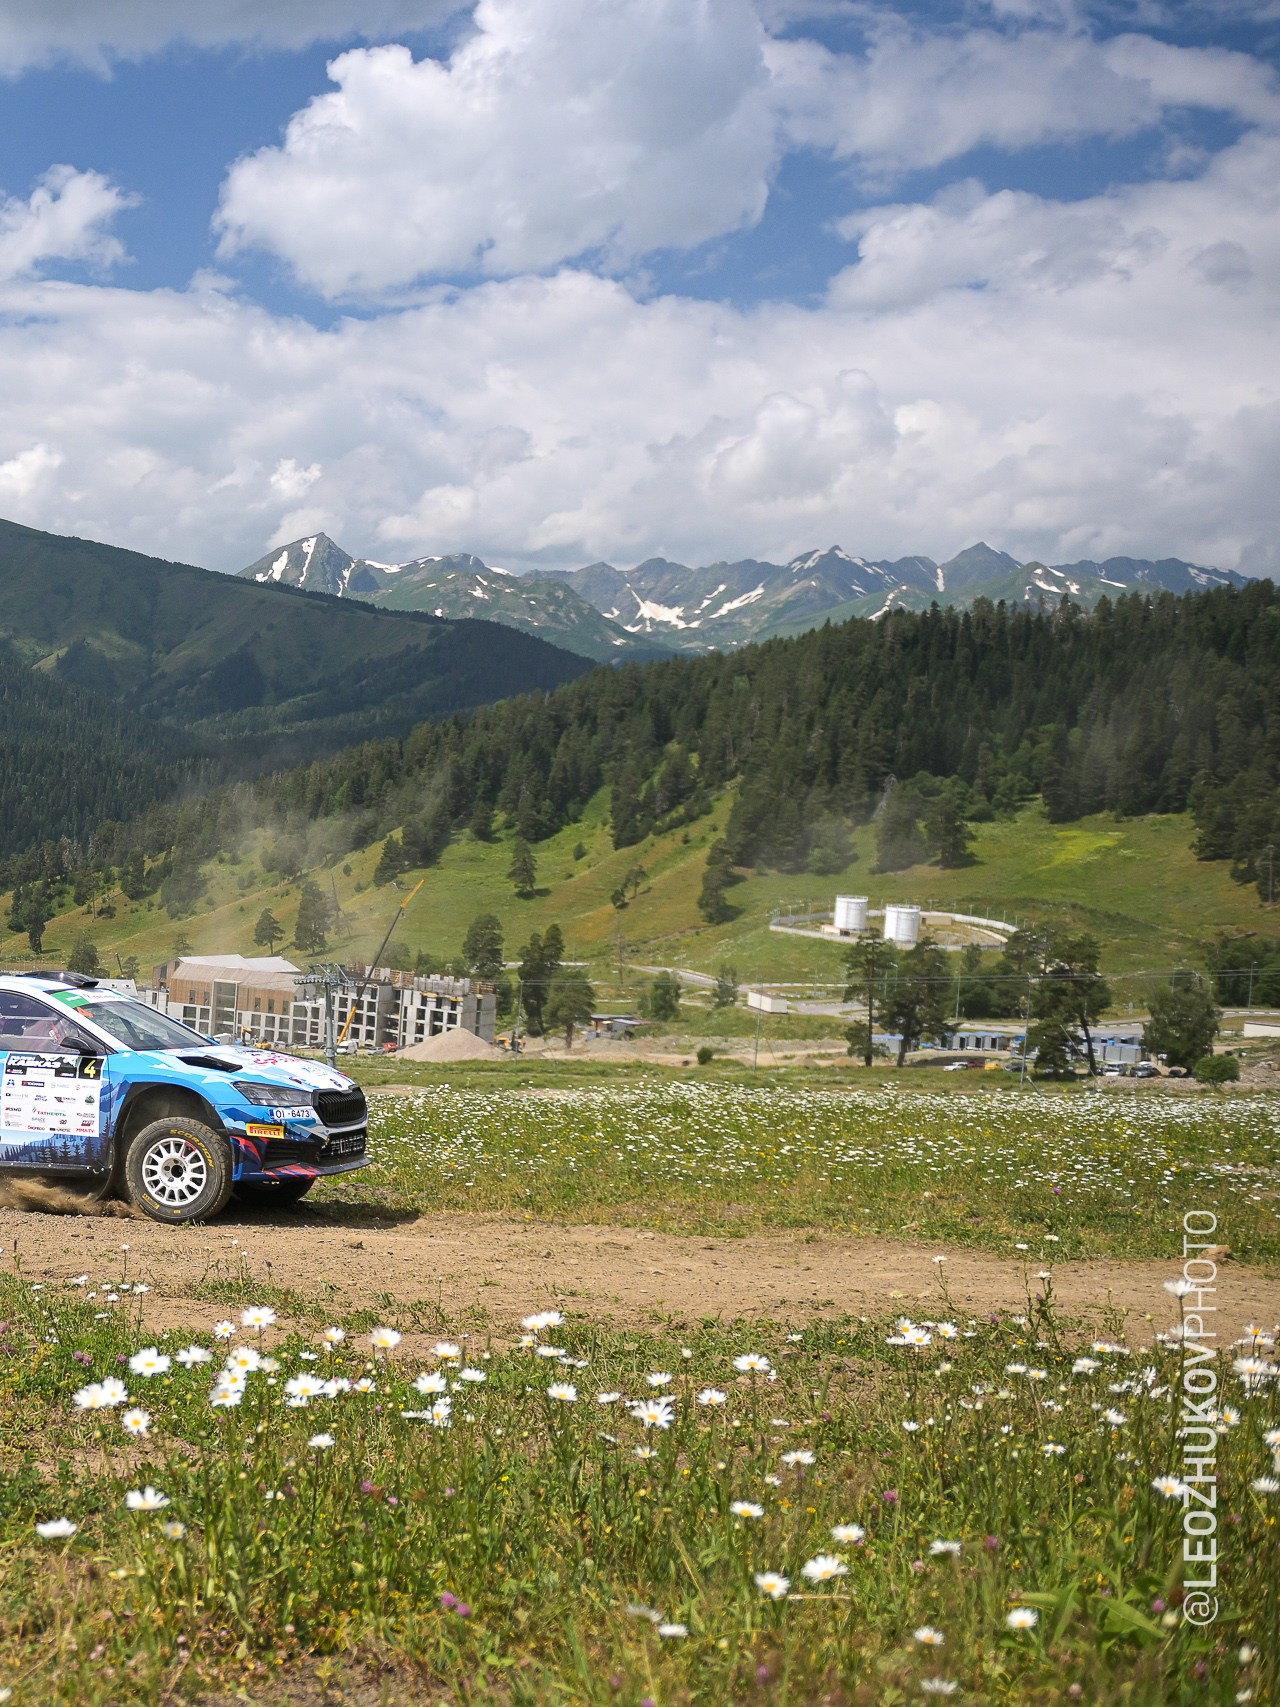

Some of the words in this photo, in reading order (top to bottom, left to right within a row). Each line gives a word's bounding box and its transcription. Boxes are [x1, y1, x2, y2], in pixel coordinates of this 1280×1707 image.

[83, 1060, 96, 1078] 4
[250, 1126, 280, 1136] PIRELLI
[169, 1129, 214, 1168] SCORPION
